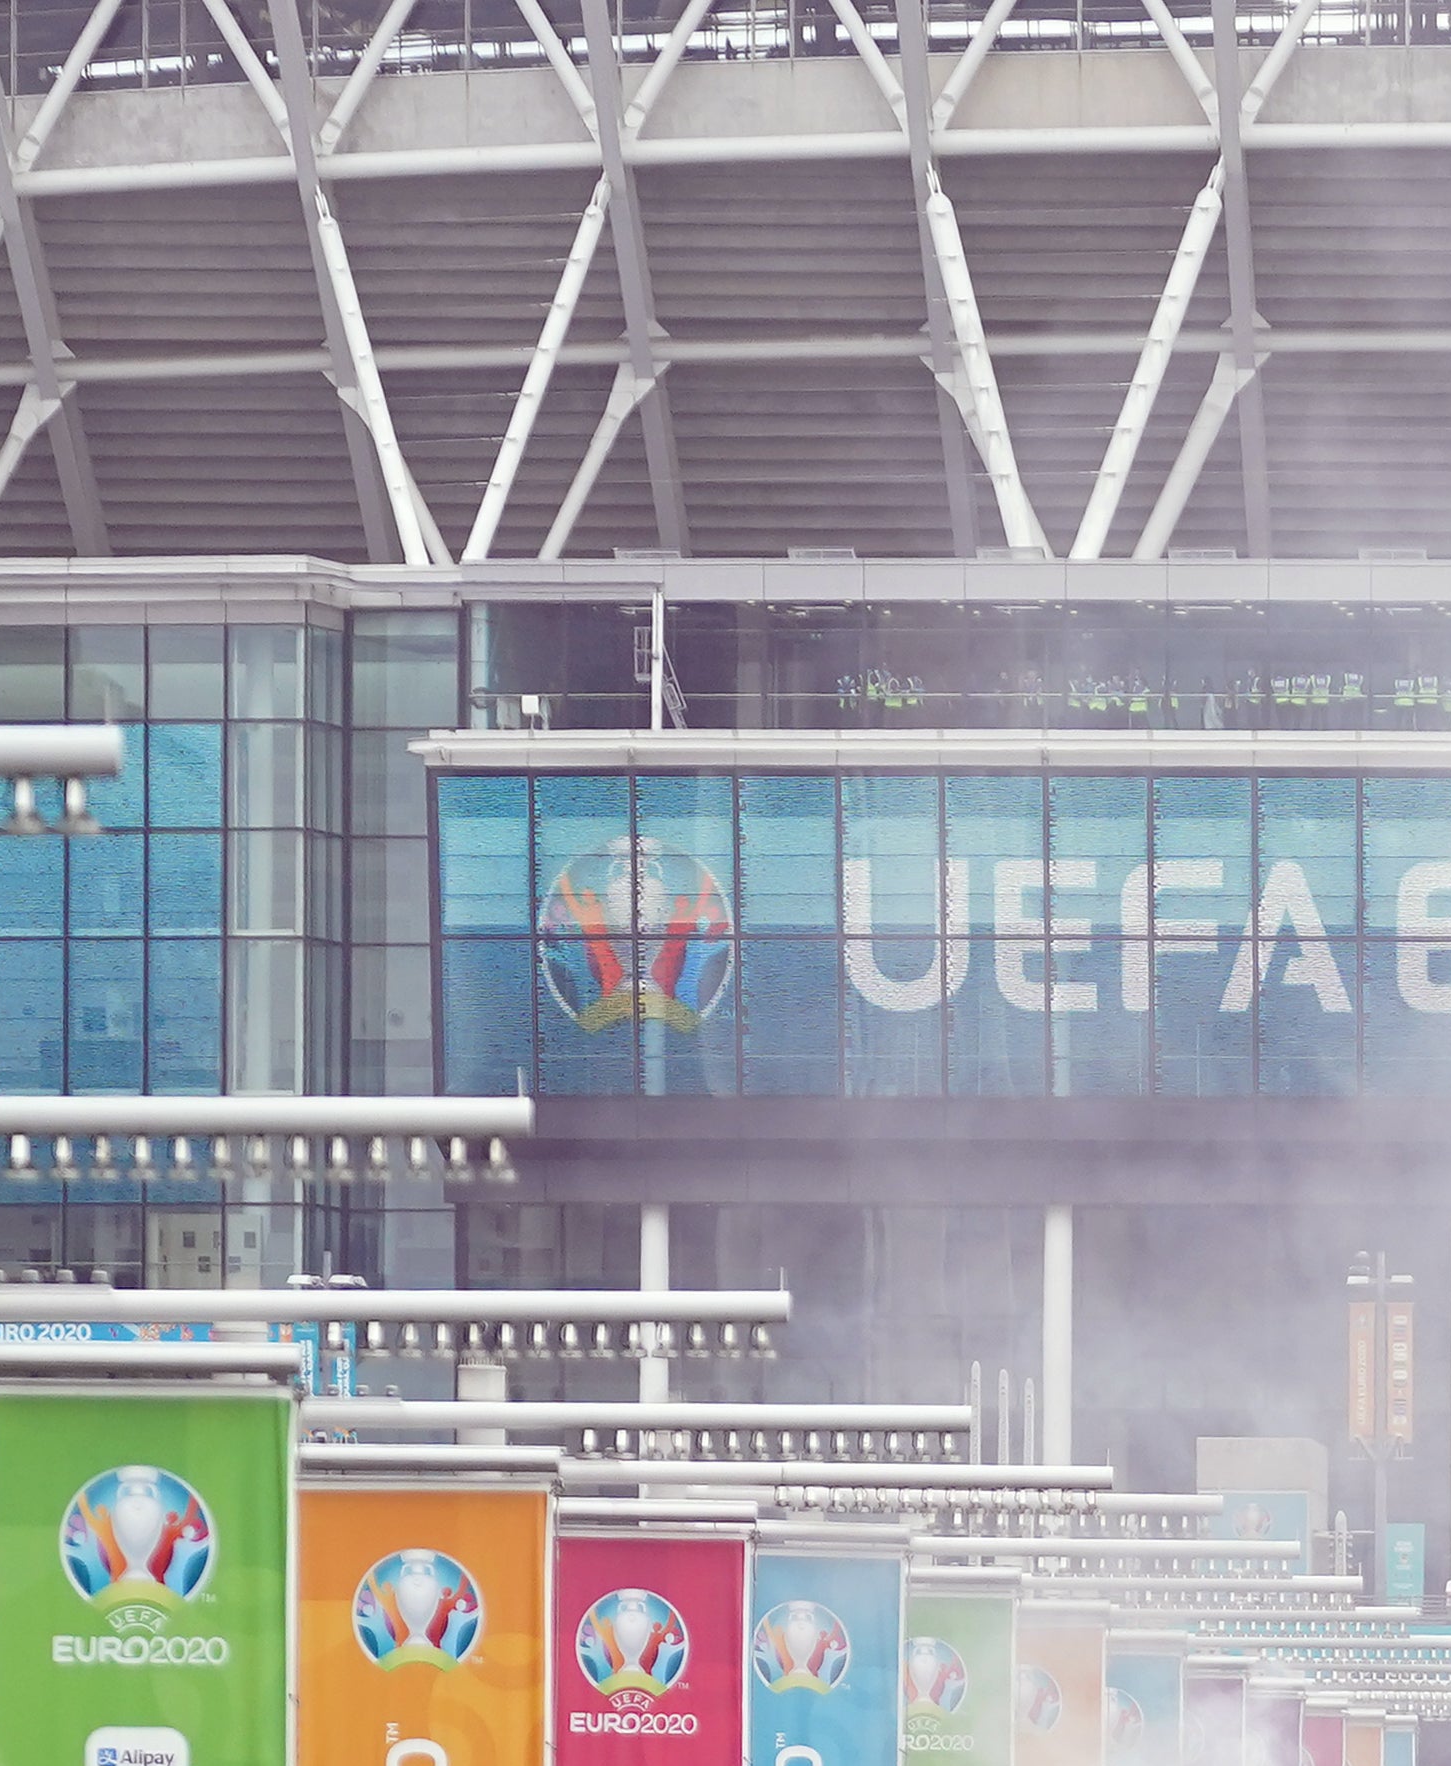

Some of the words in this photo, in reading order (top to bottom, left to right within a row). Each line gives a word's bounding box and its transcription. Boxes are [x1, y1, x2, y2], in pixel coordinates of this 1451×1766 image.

[845, 859, 1352, 1013] UEFA
[37, 1323, 91, 1341] 2020
[107, 1609, 165, 1629] UEFA
[52, 1635, 228, 1664] EURO2020
[610, 1692, 649, 1709] UEFA
[569, 1712, 698, 1735] EURO2020
